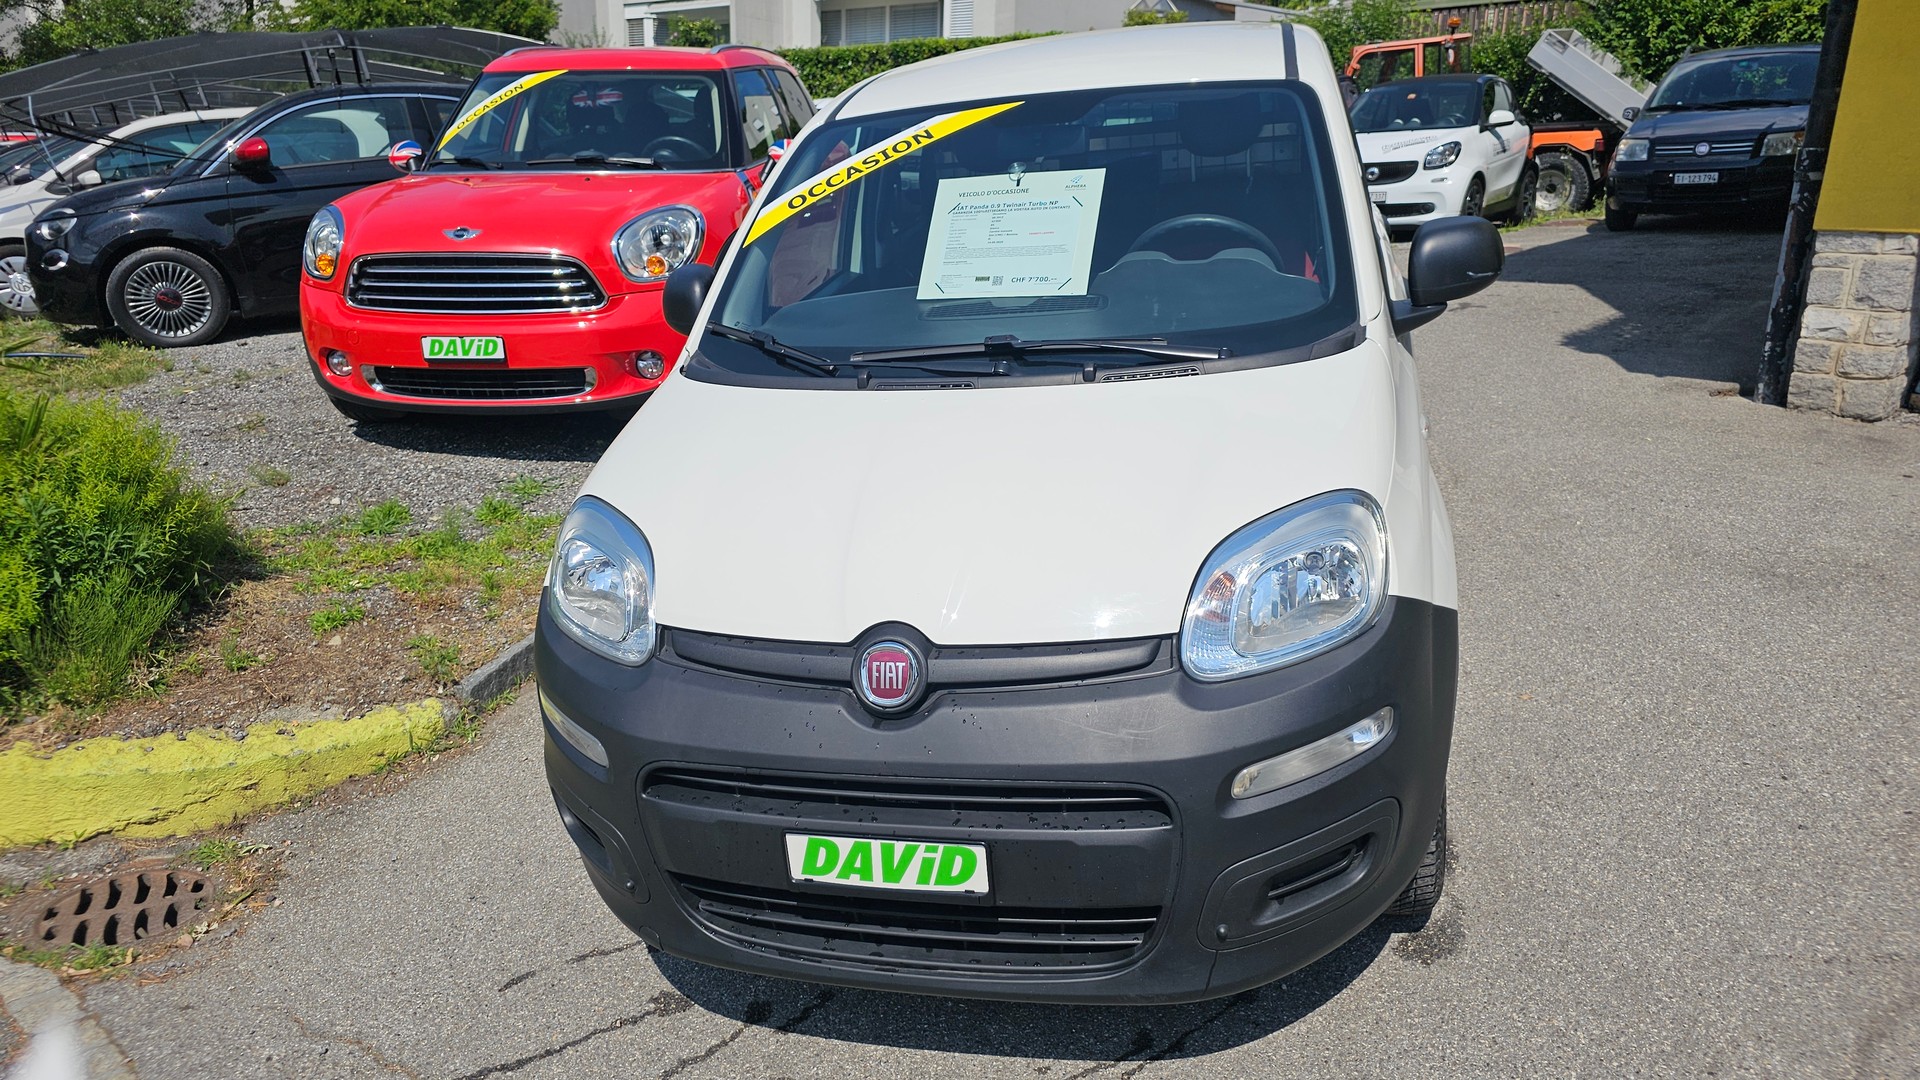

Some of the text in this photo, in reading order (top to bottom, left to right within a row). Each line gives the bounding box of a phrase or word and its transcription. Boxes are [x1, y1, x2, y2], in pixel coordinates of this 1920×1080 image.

[457, 83, 524, 130] OCCASION
[787, 129, 935, 210] OCCASION
[986, 187, 1030, 196] D'OCCASIONE
[428, 338, 499, 357] DAViD
[872, 661, 906, 689] FIAT
[801, 836, 978, 887] DAViD
